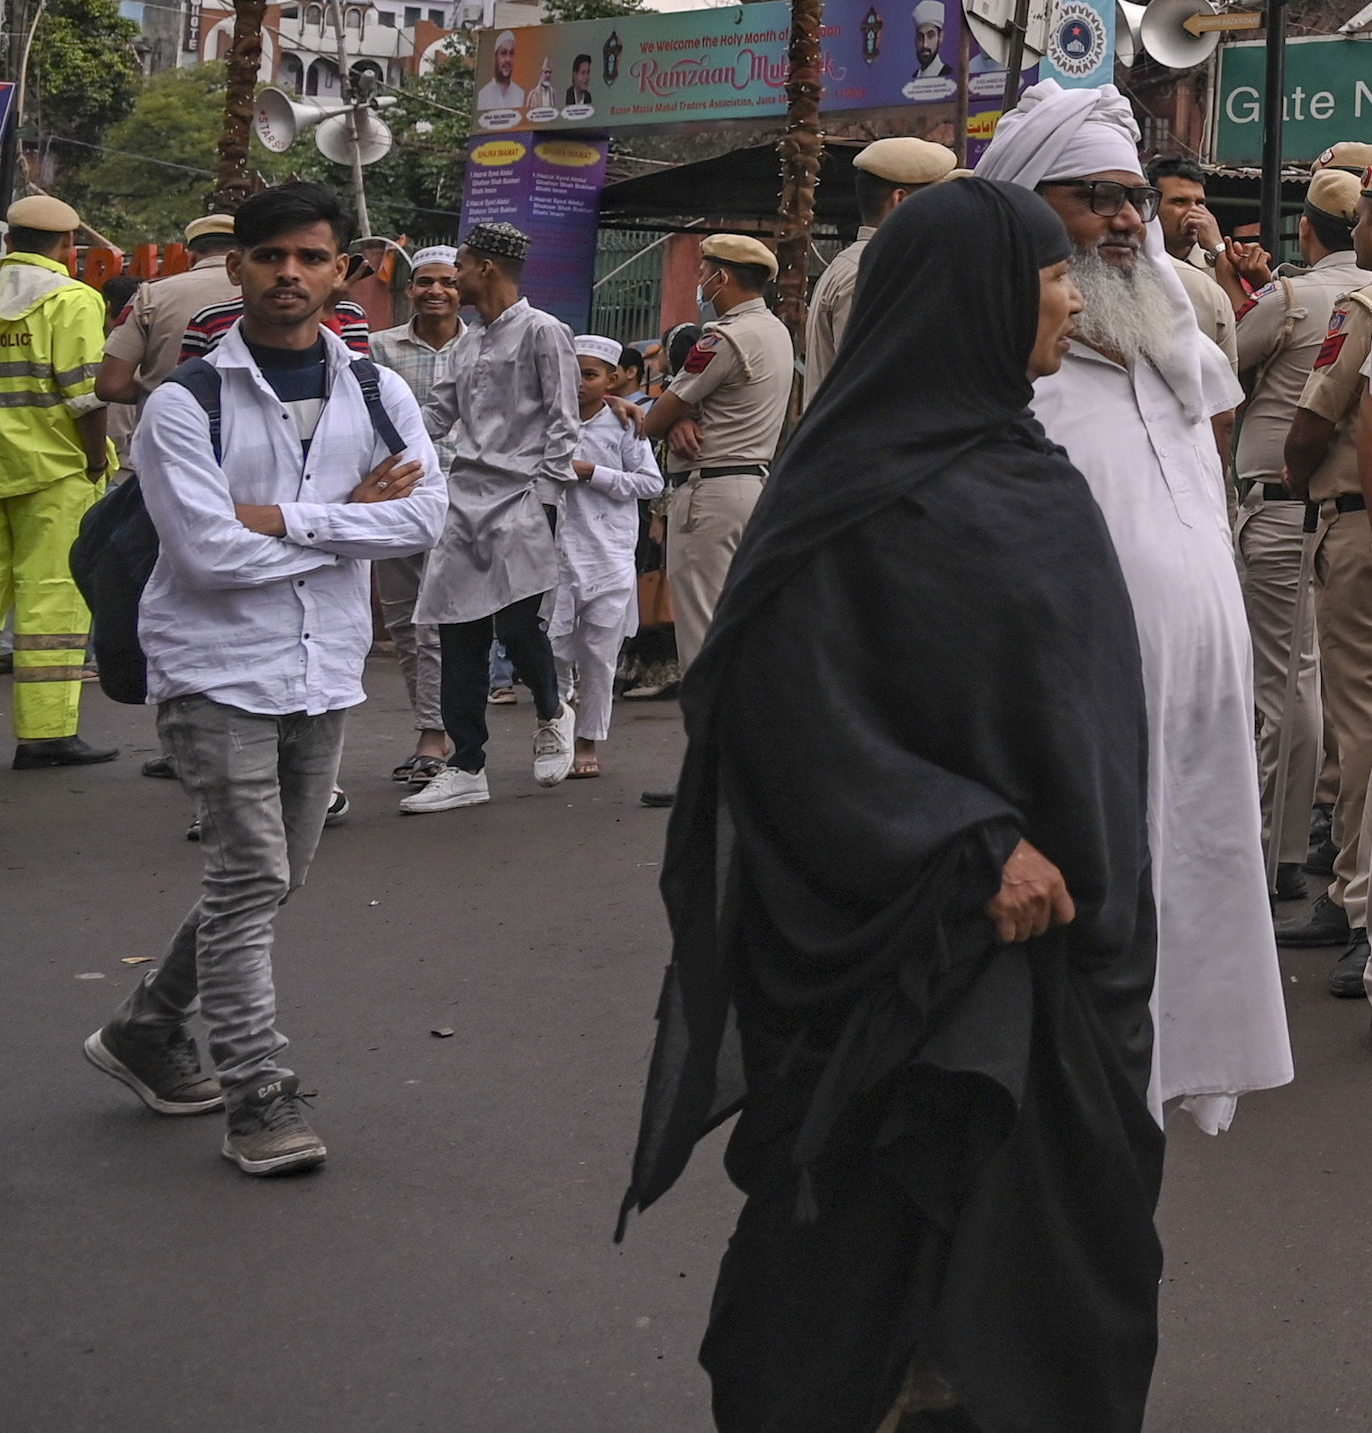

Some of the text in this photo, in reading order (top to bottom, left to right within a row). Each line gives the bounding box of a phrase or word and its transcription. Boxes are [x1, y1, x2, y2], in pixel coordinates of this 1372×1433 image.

[640, 28, 789, 53] We Welcome the Holy Month of
[629, 55, 749, 97] Ramzaan
[258, 1080, 282, 1098] CAT
